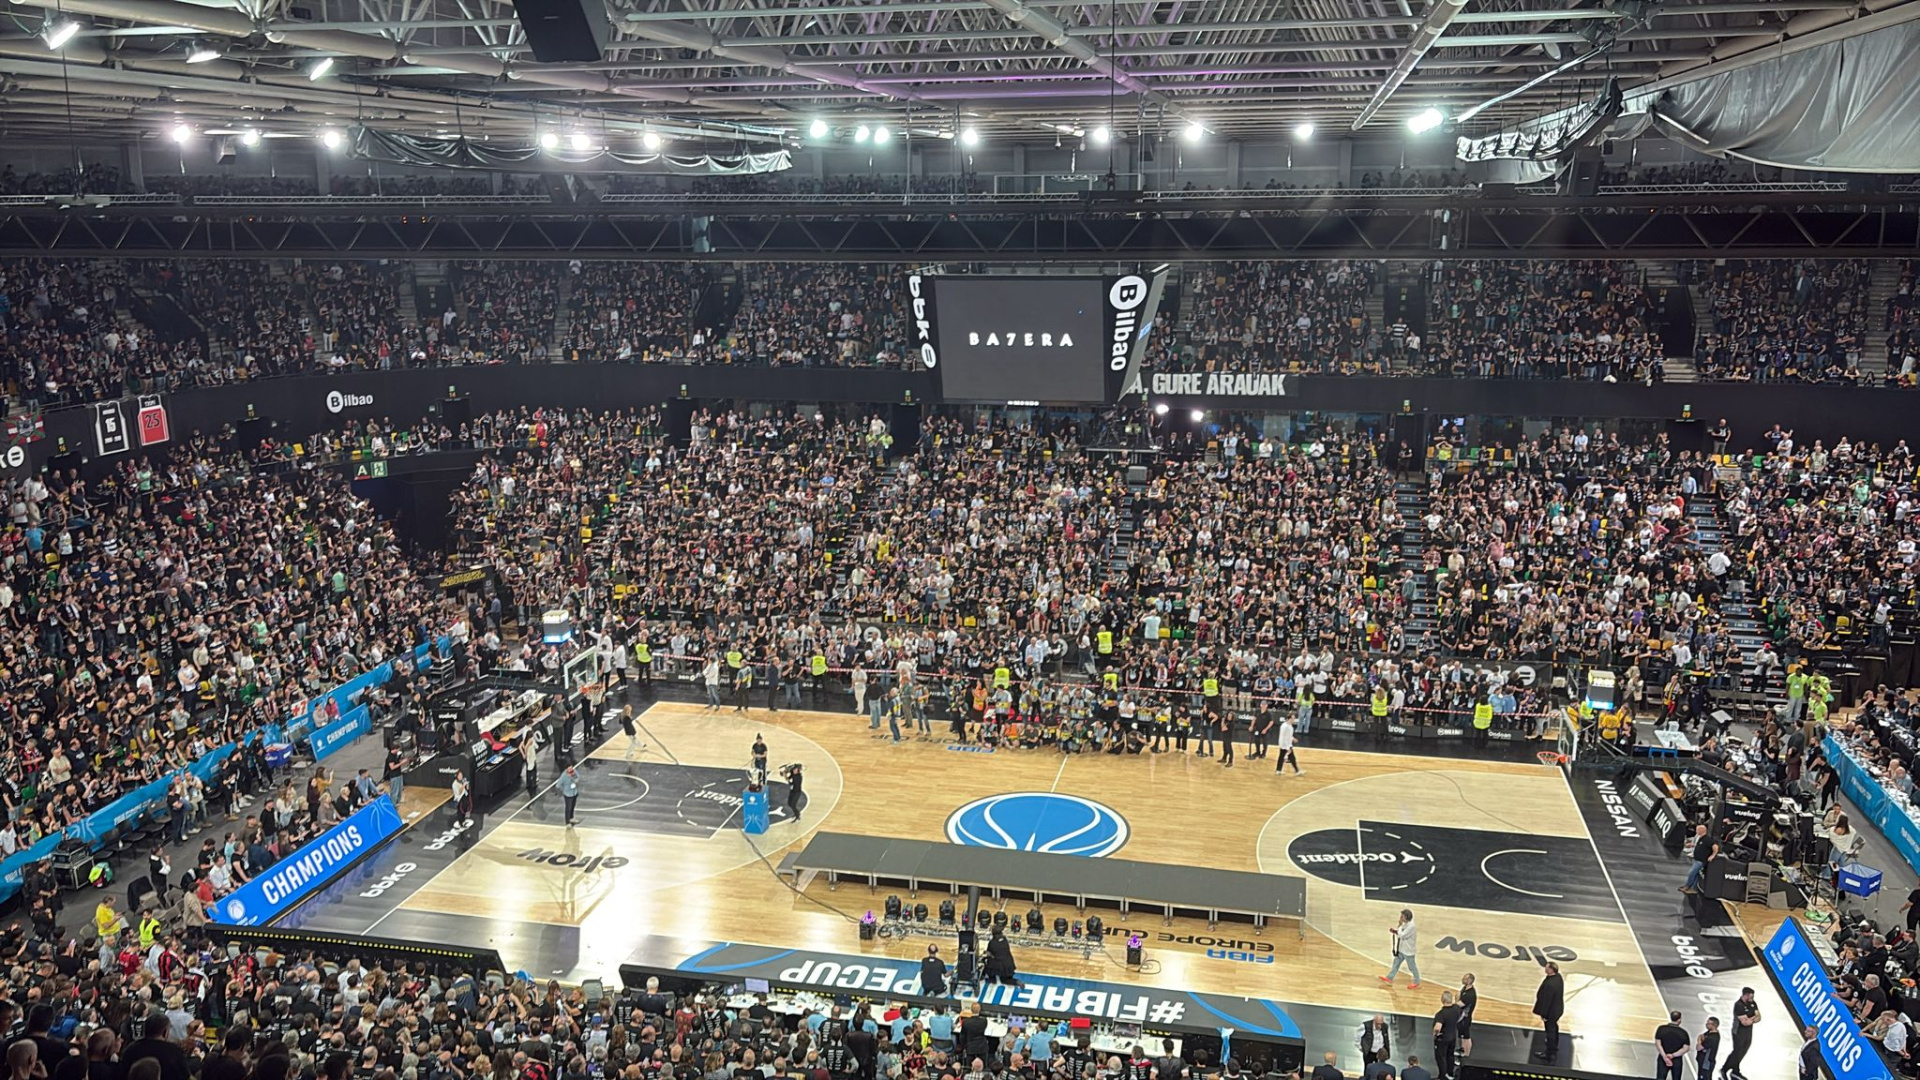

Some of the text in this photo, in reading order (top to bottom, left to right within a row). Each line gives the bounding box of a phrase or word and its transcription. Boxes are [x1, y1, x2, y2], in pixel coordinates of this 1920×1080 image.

[908, 275, 929, 341] bbk
[1109, 278, 1143, 371] Bilbao
[969, 332, 1074, 347] BA7ERA
[1152, 372, 1203, 394] GURE
[329, 392, 374, 410] Bilbao
[104, 417, 117, 433] 15
[144, 412, 160, 429] 25
[357, 464, 368, 476] A
[1594, 779, 1641, 838] NISSAN
[1734, 809, 1763, 820] vueling
[1654, 808, 1672, 839] IMQ
[261, 825, 363, 905] CHAMPIONS
[516, 847, 629, 873] elrow
[1297, 852, 1397, 865] Occident
[360, 870, 406, 898] bbk
[1724, 872, 1748, 881] vuelin
[1157, 931, 1275, 952] EUROPE
[1434, 936, 1578, 968] elrow
[1671, 935, 1703, 966] bbk
[1206, 948, 1275, 964] FIBA
[1791, 961, 1863, 1073] CHAMPIONS
